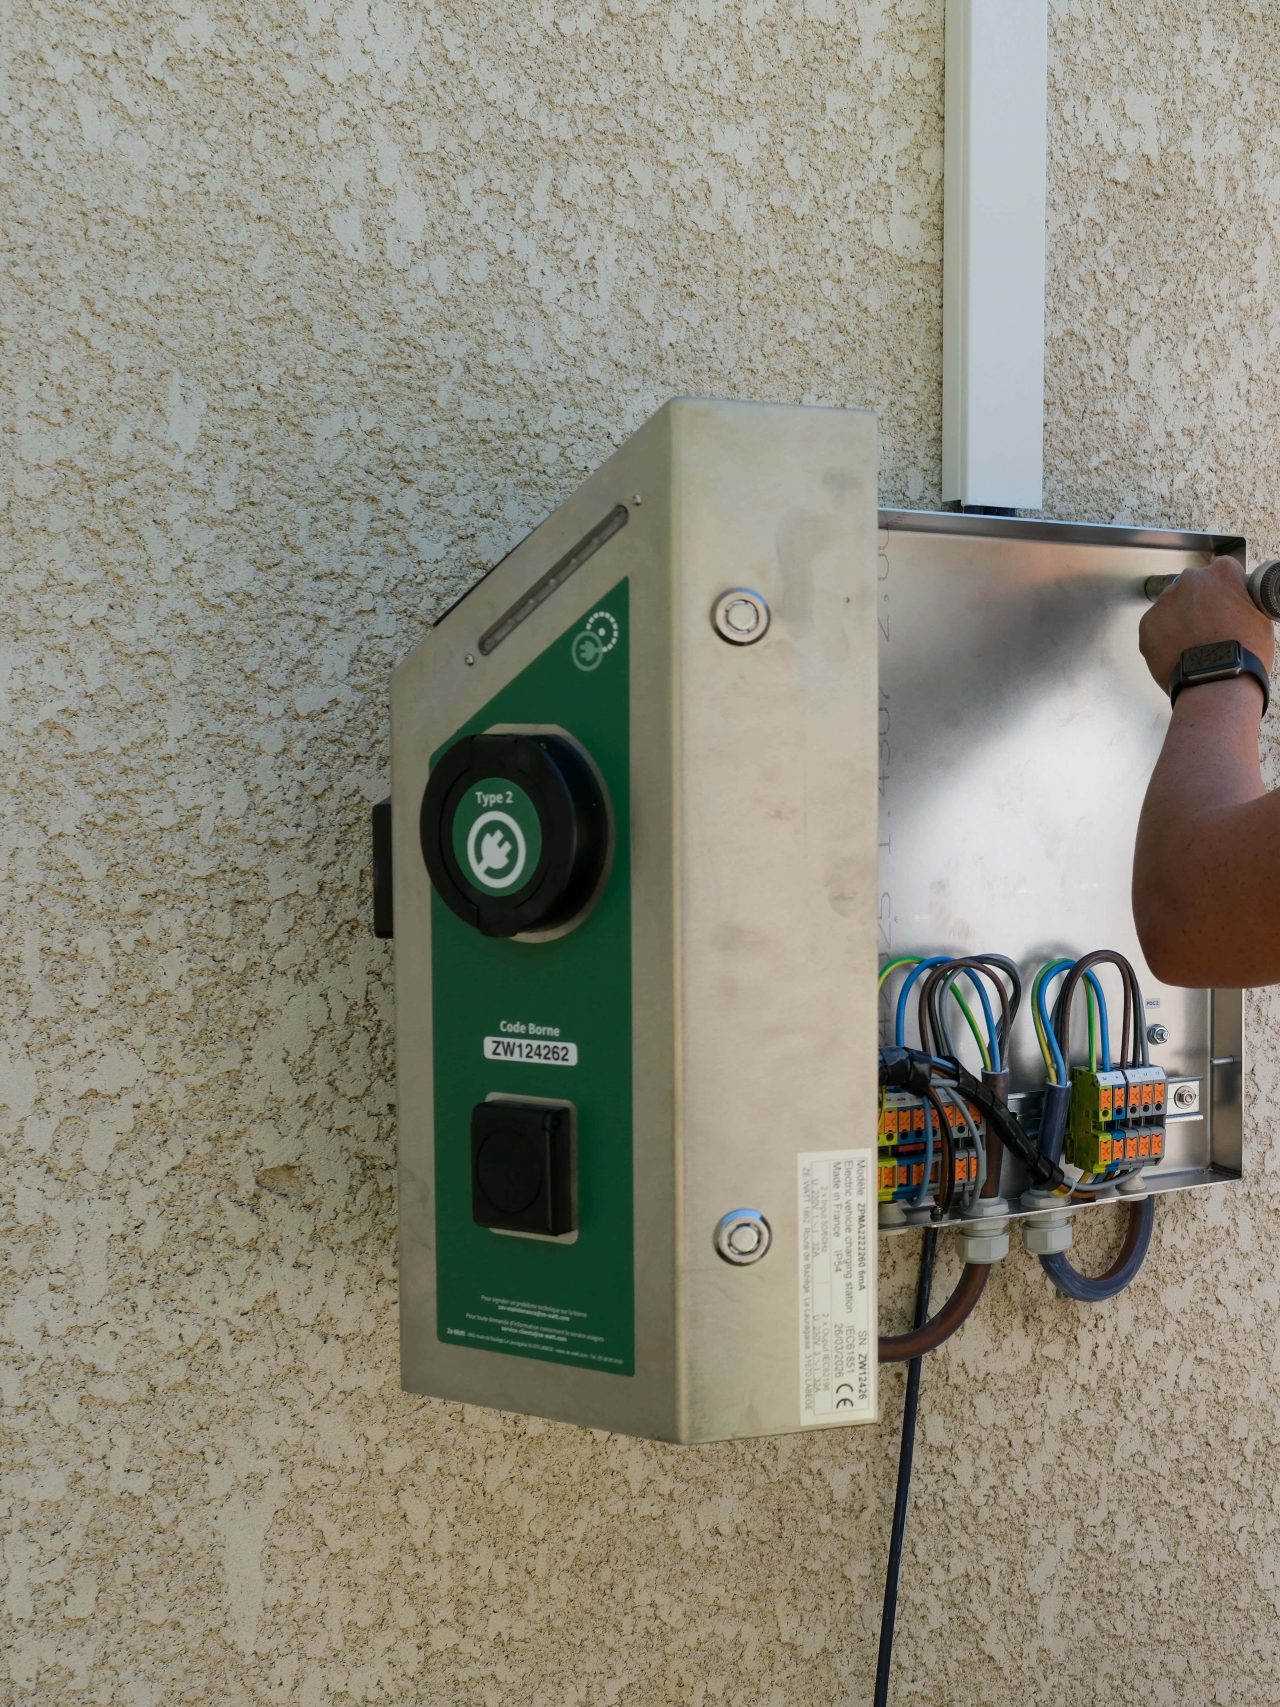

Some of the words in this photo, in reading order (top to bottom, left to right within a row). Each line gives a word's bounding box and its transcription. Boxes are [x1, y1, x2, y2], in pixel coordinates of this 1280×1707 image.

[475, 791, 503, 807] Type
[505, 791, 513, 803] 2
[499, 1020, 526, 1034] Code
[528, 1023, 561, 1037] Borne
[491, 1040, 570, 1062] ZW124262
[832, 1161, 841, 1189] Made
[844, 1160, 853, 1197] Electric
[832, 1192, 841, 1200] in
[832, 1203, 842, 1238] France
[844, 1200, 853, 1233] vehicle
[833, 1250, 842, 1273] IP54
[843, 1236, 853, 1279] charging
[845, 1282, 853, 1313] station
